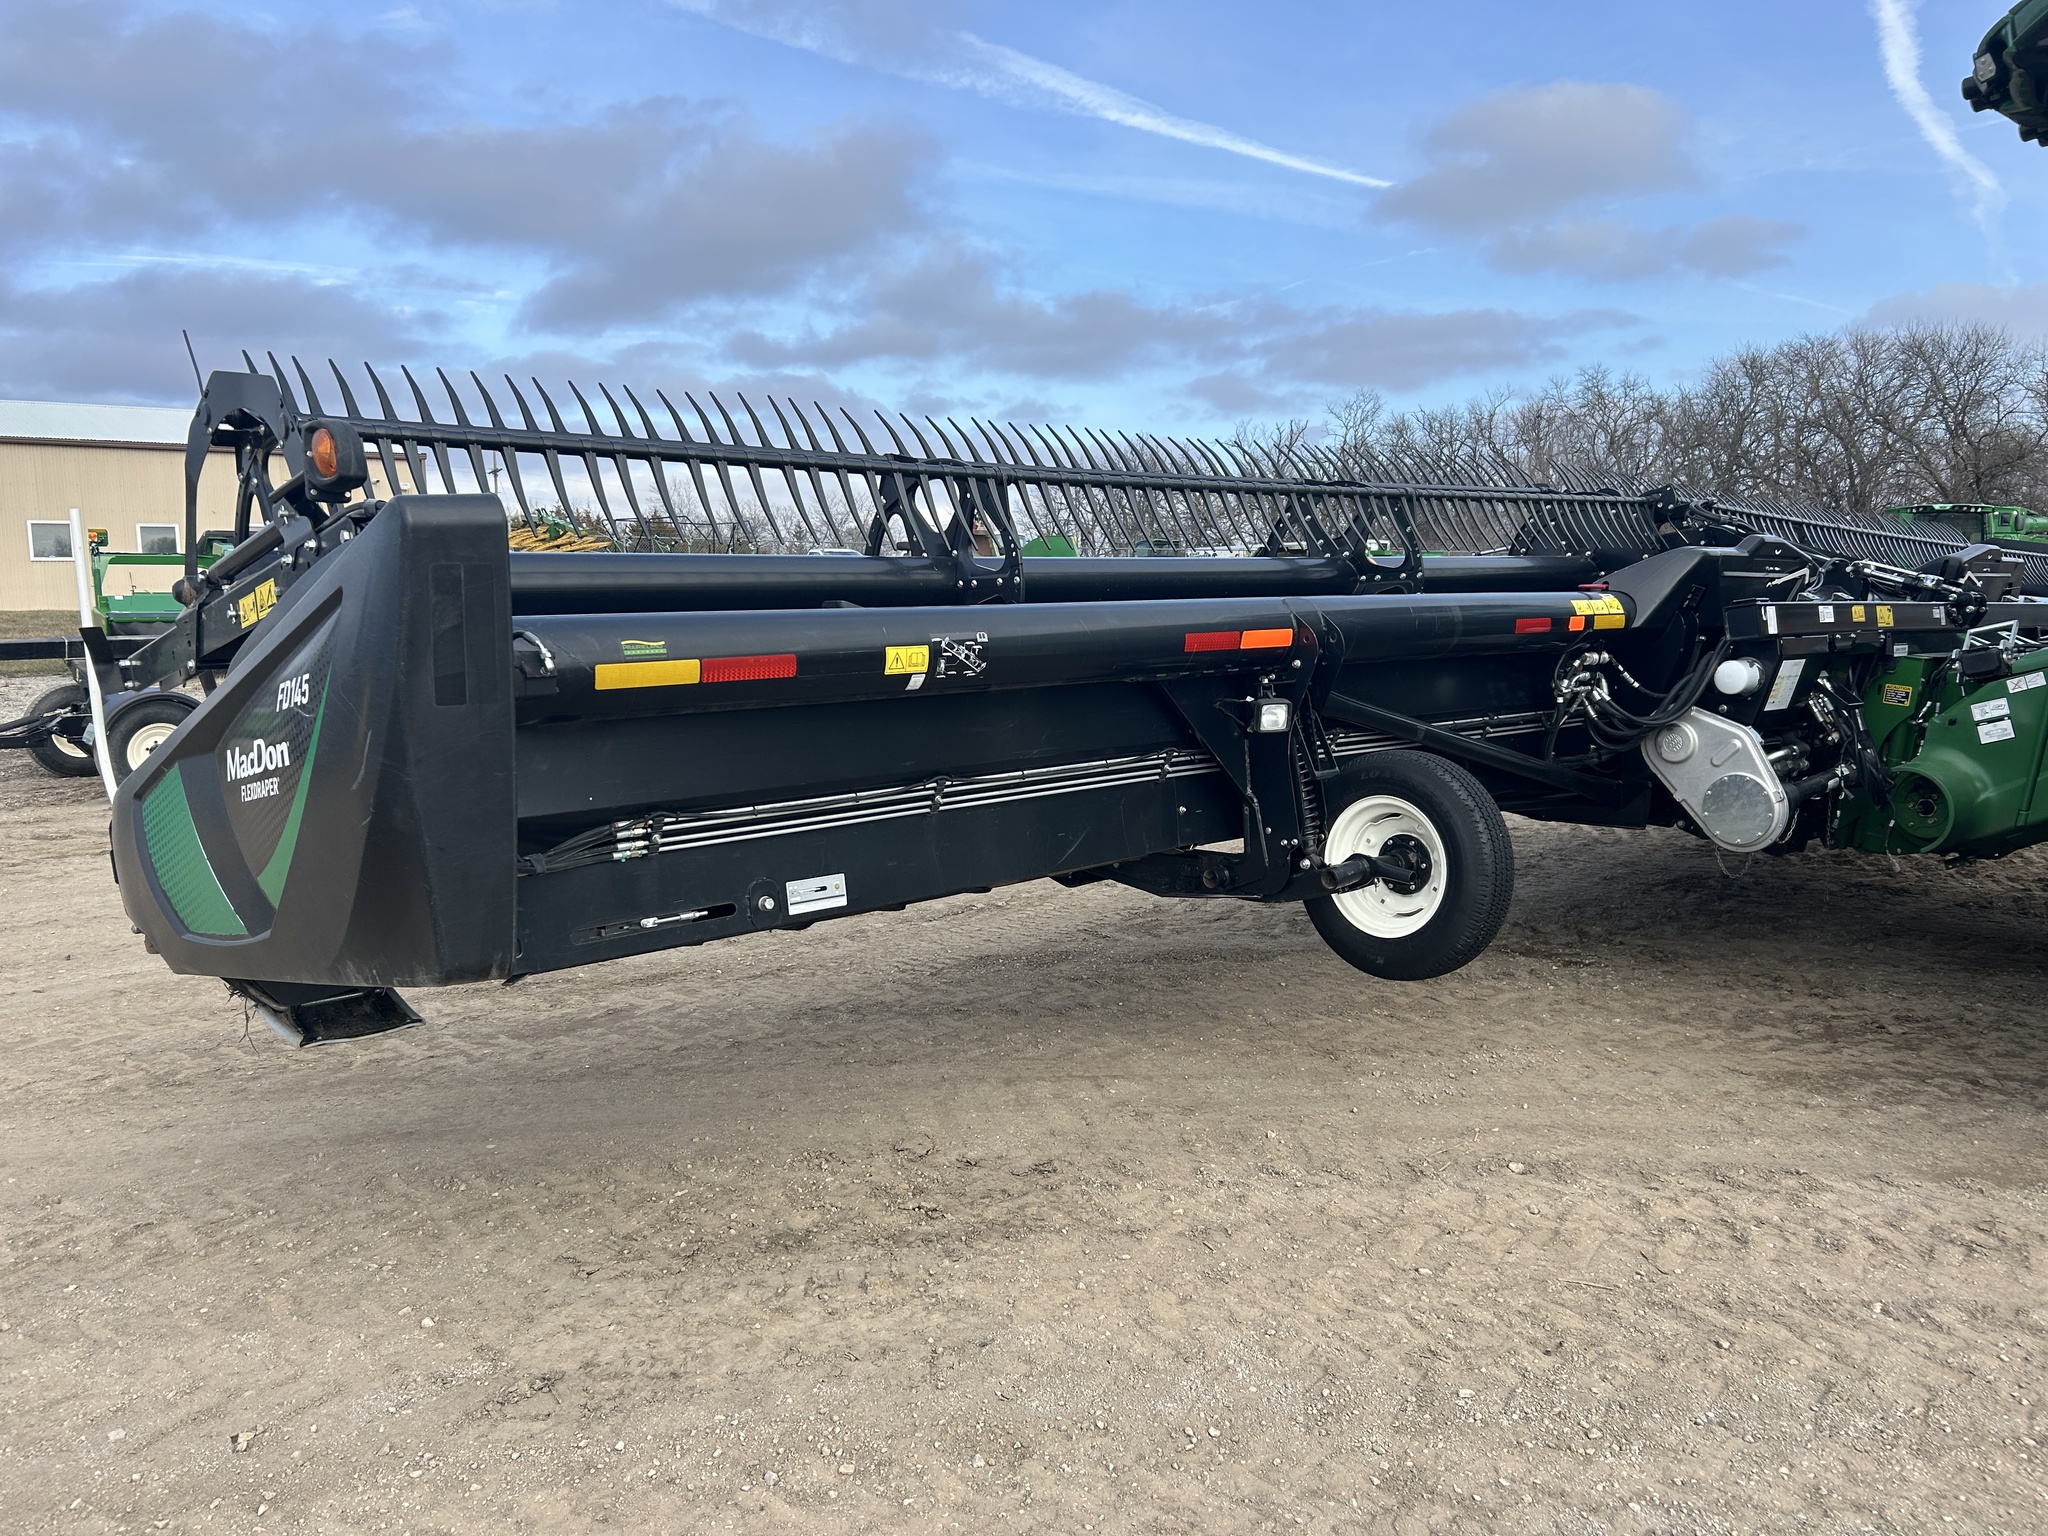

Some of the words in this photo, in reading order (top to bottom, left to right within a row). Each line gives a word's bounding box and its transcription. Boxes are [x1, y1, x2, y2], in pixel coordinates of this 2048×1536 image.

[276, 673, 310, 712] FD145
[227, 738, 290, 781] MacDon
[241, 777, 279, 803] FLEXDRAPER
